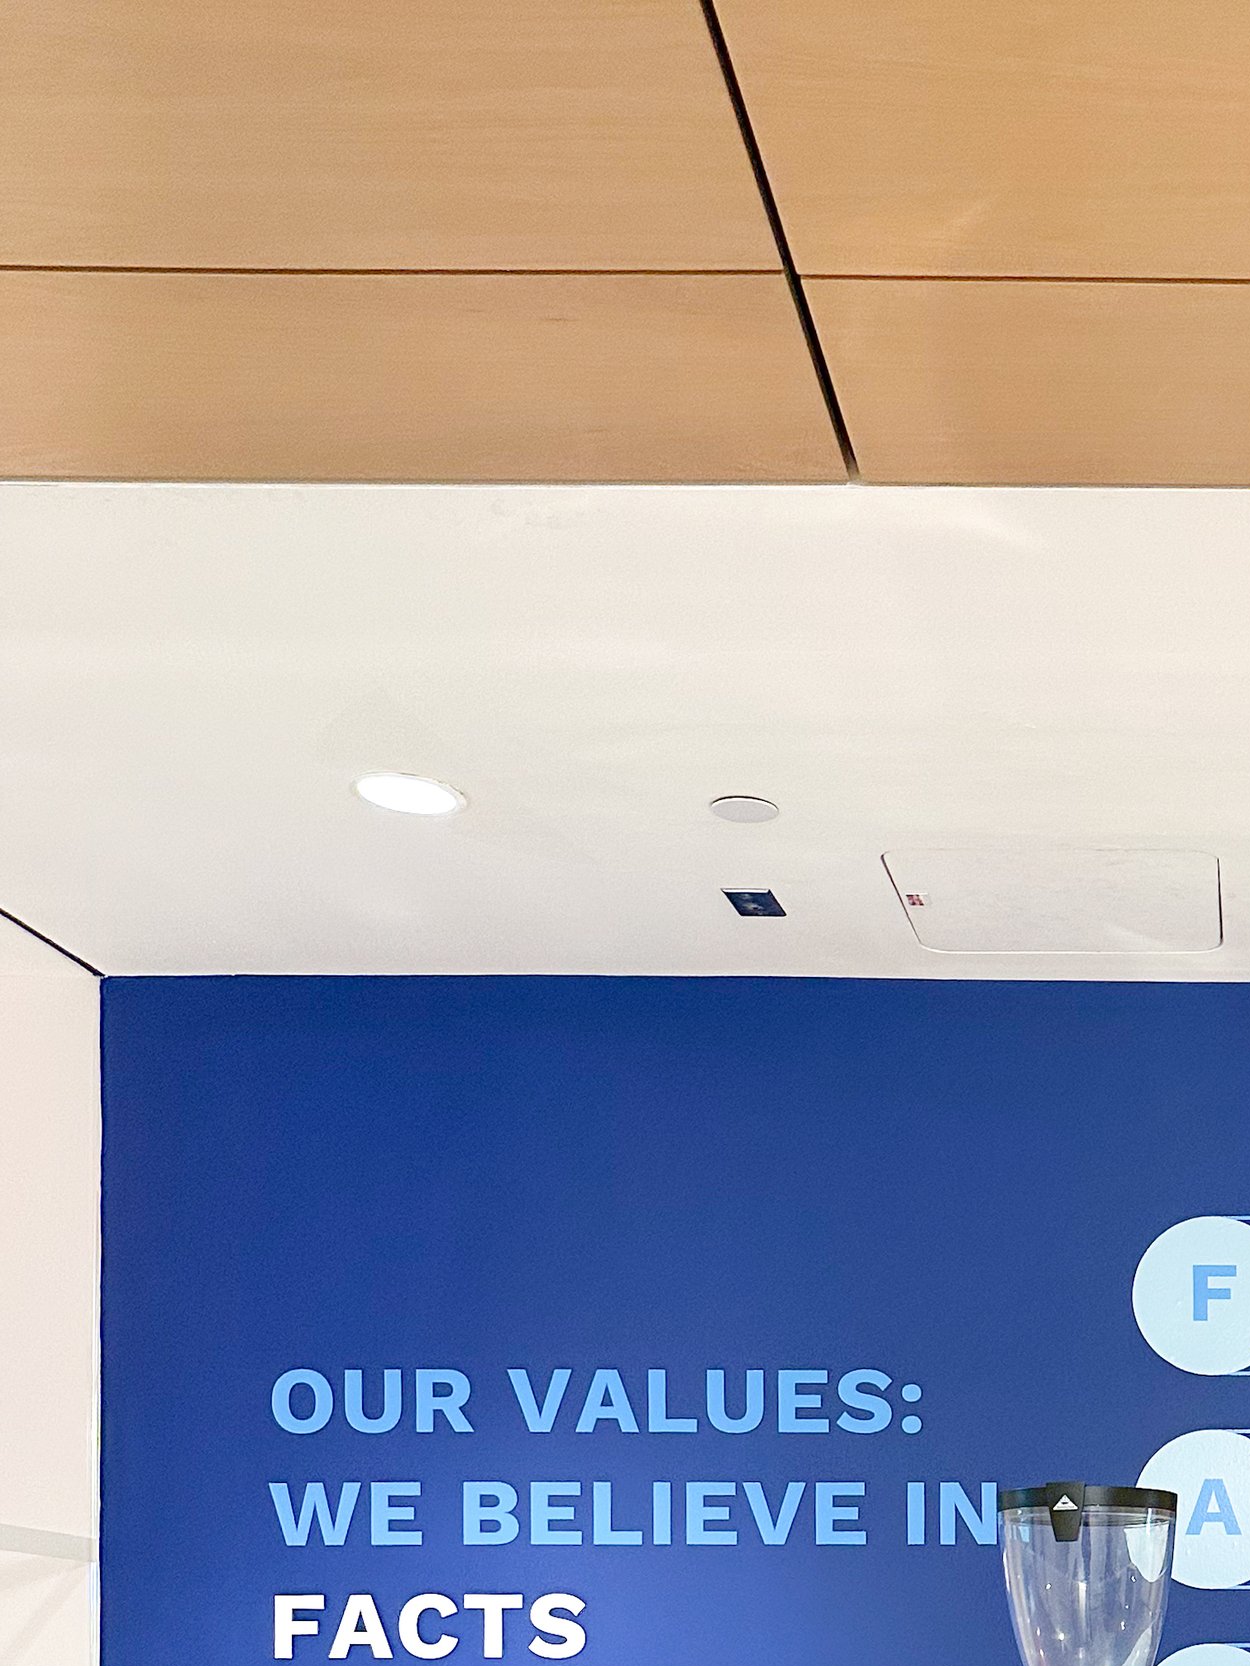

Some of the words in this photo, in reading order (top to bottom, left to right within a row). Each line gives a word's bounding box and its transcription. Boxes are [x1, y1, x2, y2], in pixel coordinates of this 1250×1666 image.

[1192, 1264, 1238, 1322] F
[271, 1368, 475, 1435] OUR
[506, 1368, 923, 1435] VALUES:
[268, 1481, 424, 1547] WE
[462, 1481, 867, 1547] BELIEVE
[906, 1481, 998, 1547] IN
[1185, 1478, 1243, 1536] A
[273, 1592, 587, 1660] FACTS
